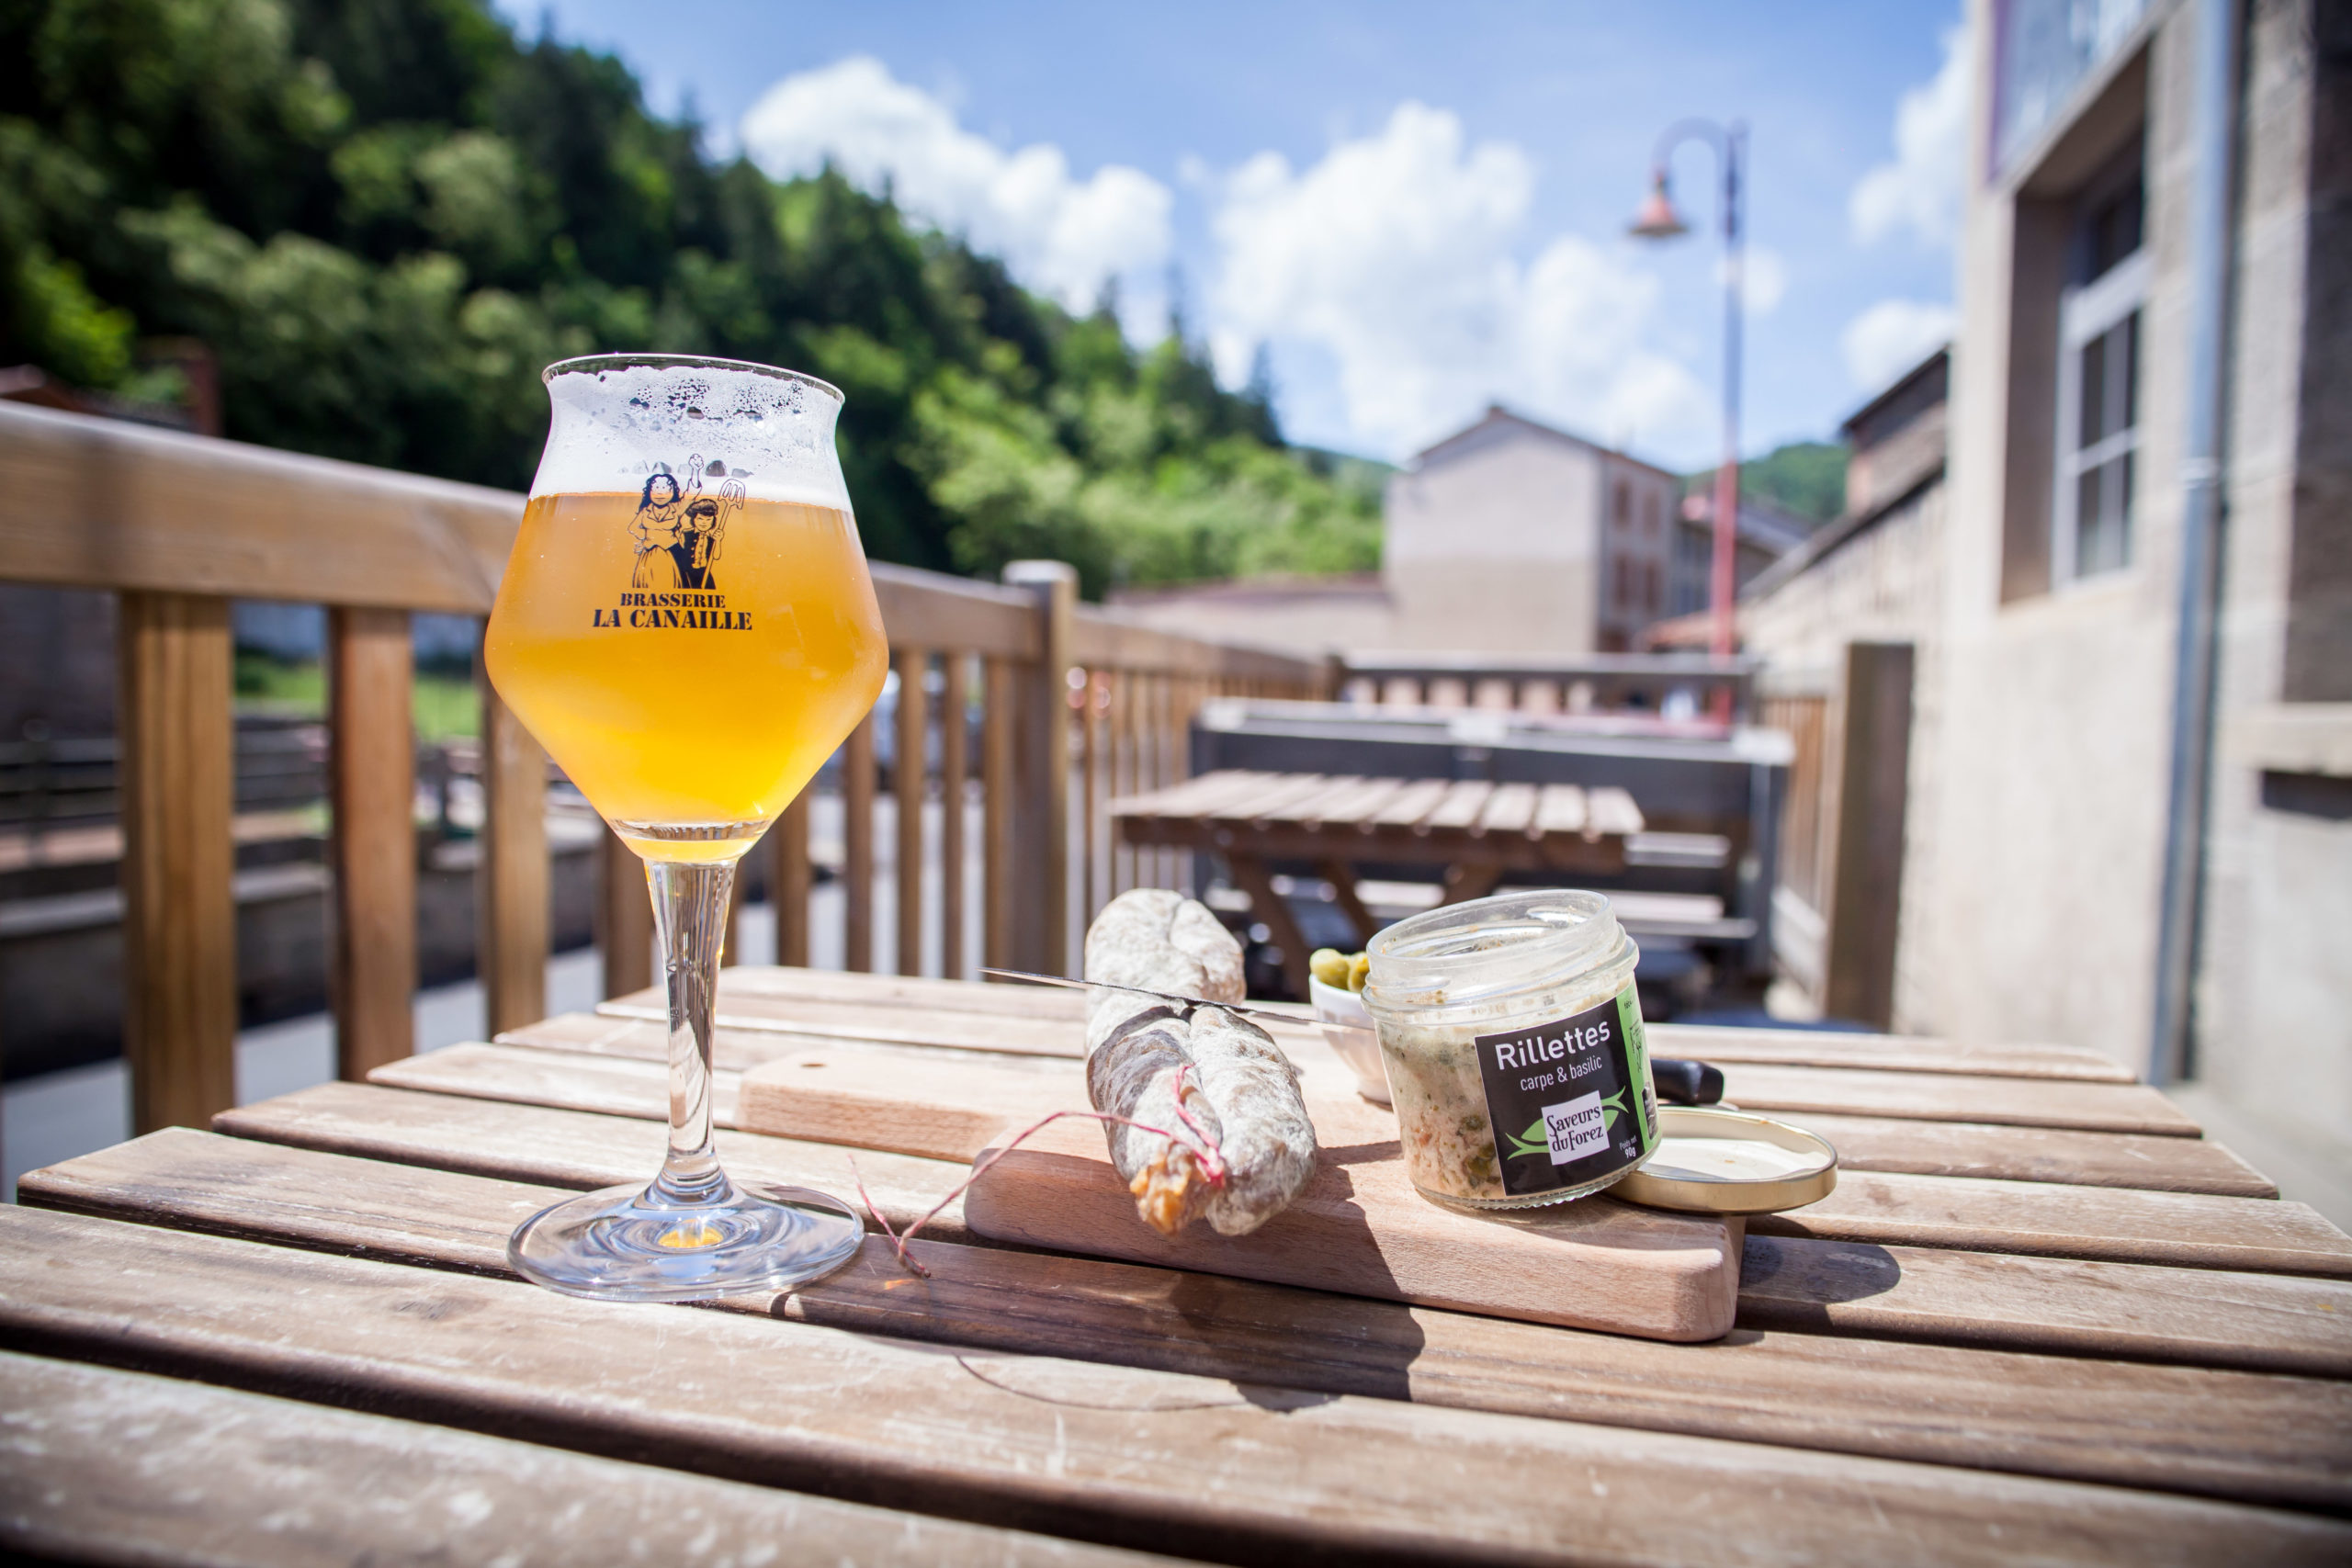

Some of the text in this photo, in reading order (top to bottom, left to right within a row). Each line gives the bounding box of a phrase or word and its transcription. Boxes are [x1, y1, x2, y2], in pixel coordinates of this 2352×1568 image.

[620, 592, 726, 608] BRASSERIE
[593, 609, 752, 630] LA CANAILLE
[1495, 1021, 1611, 1070] Rillettes
[1520, 1055, 1602, 1091] carpe & basilic
[1546, 1106, 1600, 1137] Saveurs
